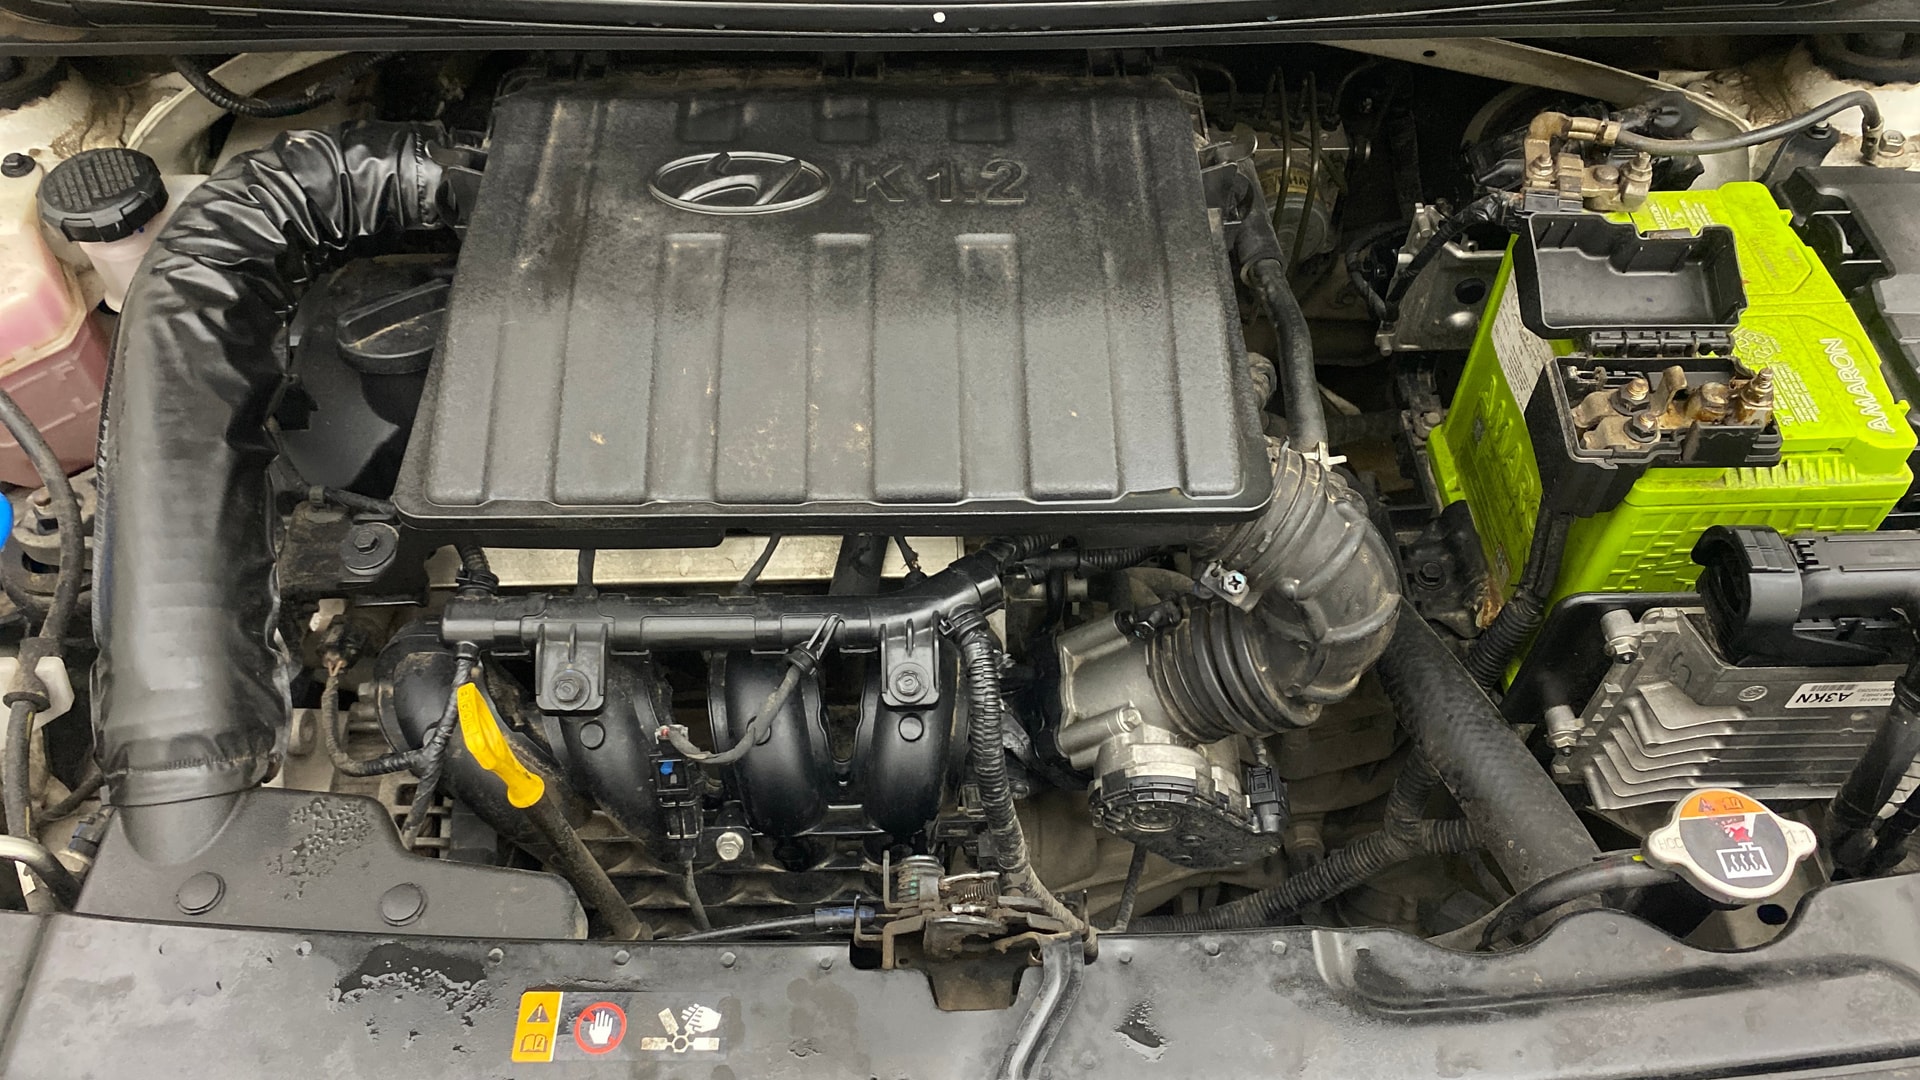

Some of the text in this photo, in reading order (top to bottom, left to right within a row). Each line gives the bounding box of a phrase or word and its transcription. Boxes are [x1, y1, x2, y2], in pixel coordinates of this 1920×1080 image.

[853, 158, 1028, 204] K 1.2
[1820, 337, 1897, 434] AMARON
[1795, 692, 1854, 704] A3KN
